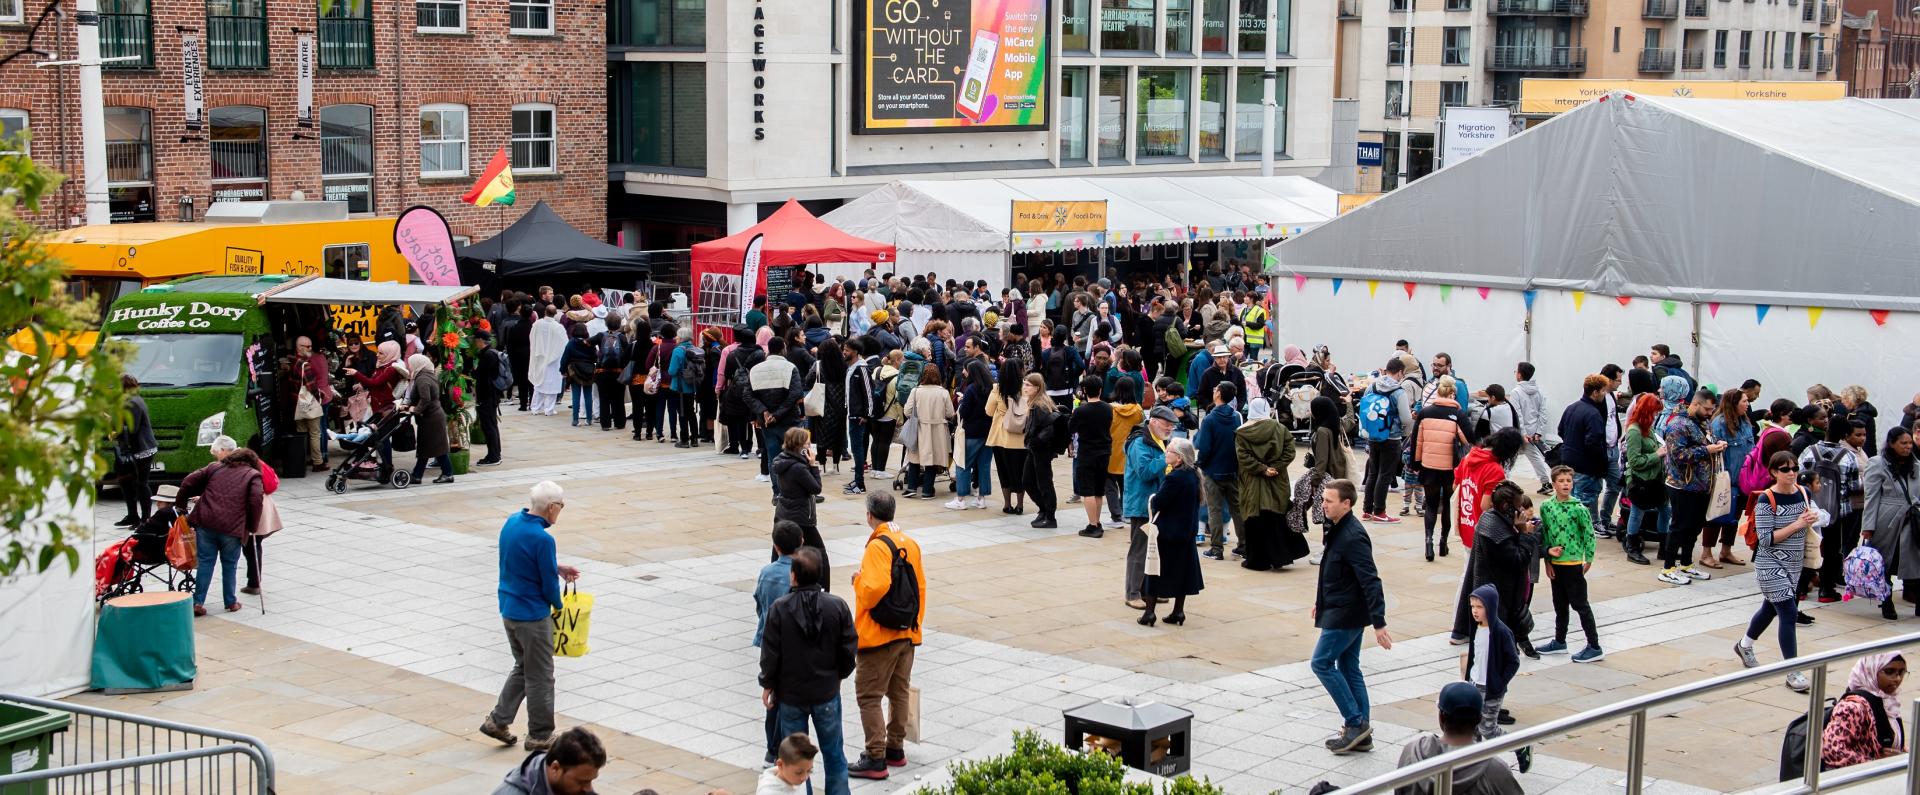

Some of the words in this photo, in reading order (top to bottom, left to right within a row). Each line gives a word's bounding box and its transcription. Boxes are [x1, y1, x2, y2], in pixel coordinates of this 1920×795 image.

[885, 0, 920, 23] GO
[1004, 12, 1028, 21] Switch
[1030, 13, 1038, 21] to
[1061, 14, 1085, 25] Dance
[1005, 25, 1017, 33] the
[885, 28, 963, 46] WITHOUT
[1004, 37, 1034, 47] MCard
[914, 48, 946, 65] THE
[1004, 53, 1036, 63] Mobile
[184, 50, 193, 86] EVENTS
[190, 41, 202, 101] EXPERIENCES
[752, 0, 767, 140] AGEWORKS
[893, 67, 940, 84] CARD
[1004, 69, 1023, 81] App
[1745, 90, 1788, 98] Yorkshire
[898, 102, 930, 110] smartphone.
[1458, 123, 1496, 133] Migration
[1458, 131, 1495, 139] Yorkshire
[216, 189, 264, 197] CARRIAGEWORKS
[324, 184, 369, 193] CARRIAGEWORKS
[325, 192, 348, 201] THEATRE
[234, 254, 254, 264] QUALITY
[229, 263, 240, 273] FISH
[244, 264, 258, 274] CHIPS
[110, 302, 185, 323] Hunky
[188, 301, 248, 321] Dory
[137, 318, 186, 330] Coffee
[188, 318, 211, 328] Co
[553, 632, 568, 656] R
